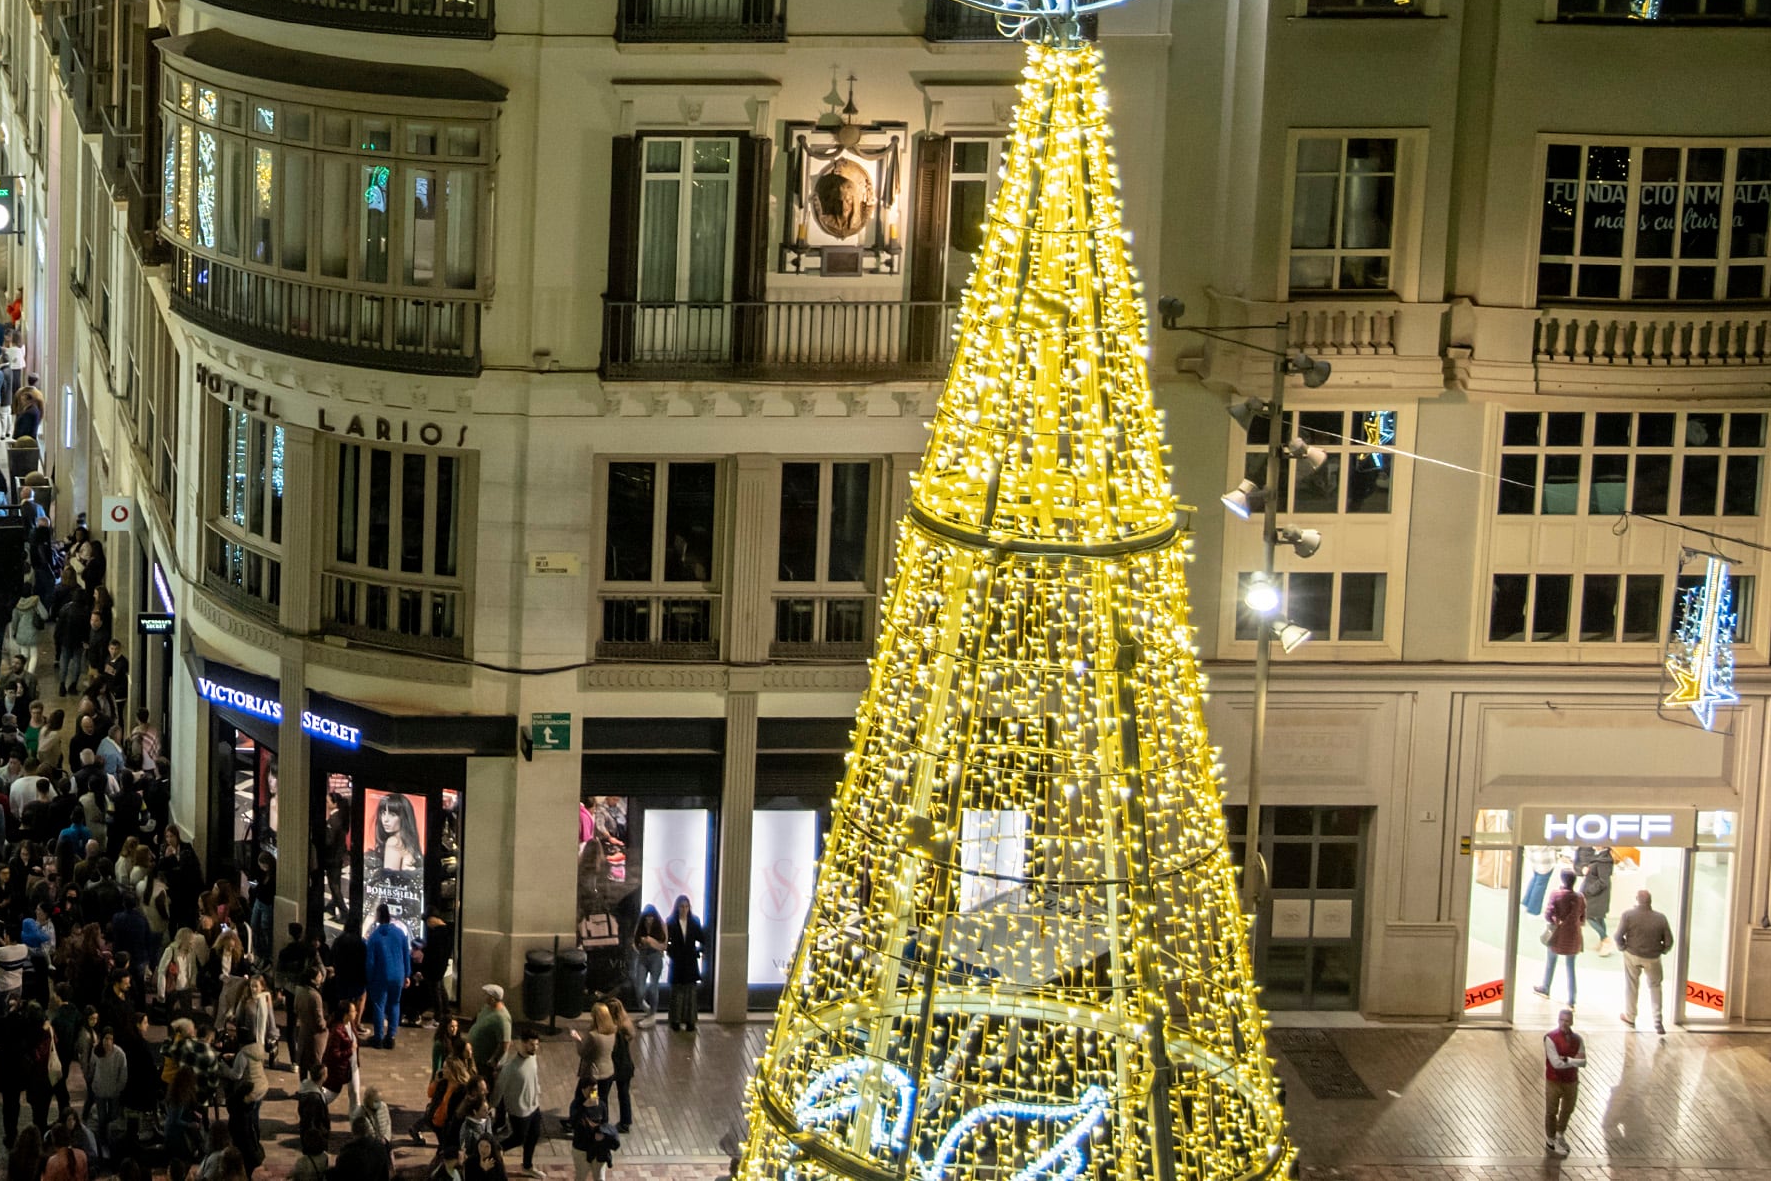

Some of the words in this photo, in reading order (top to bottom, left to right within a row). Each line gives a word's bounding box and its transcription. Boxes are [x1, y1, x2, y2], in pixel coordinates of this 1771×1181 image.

[196, 362, 280, 419] HOTEL
[318, 407, 469, 447] LARIOS
[198, 677, 283, 719] VICTORIA'S
[302, 710, 359, 744] SECRET
[1544, 813, 1672, 841] HOFF
[366, 885, 420, 901] BOMBSHELL
